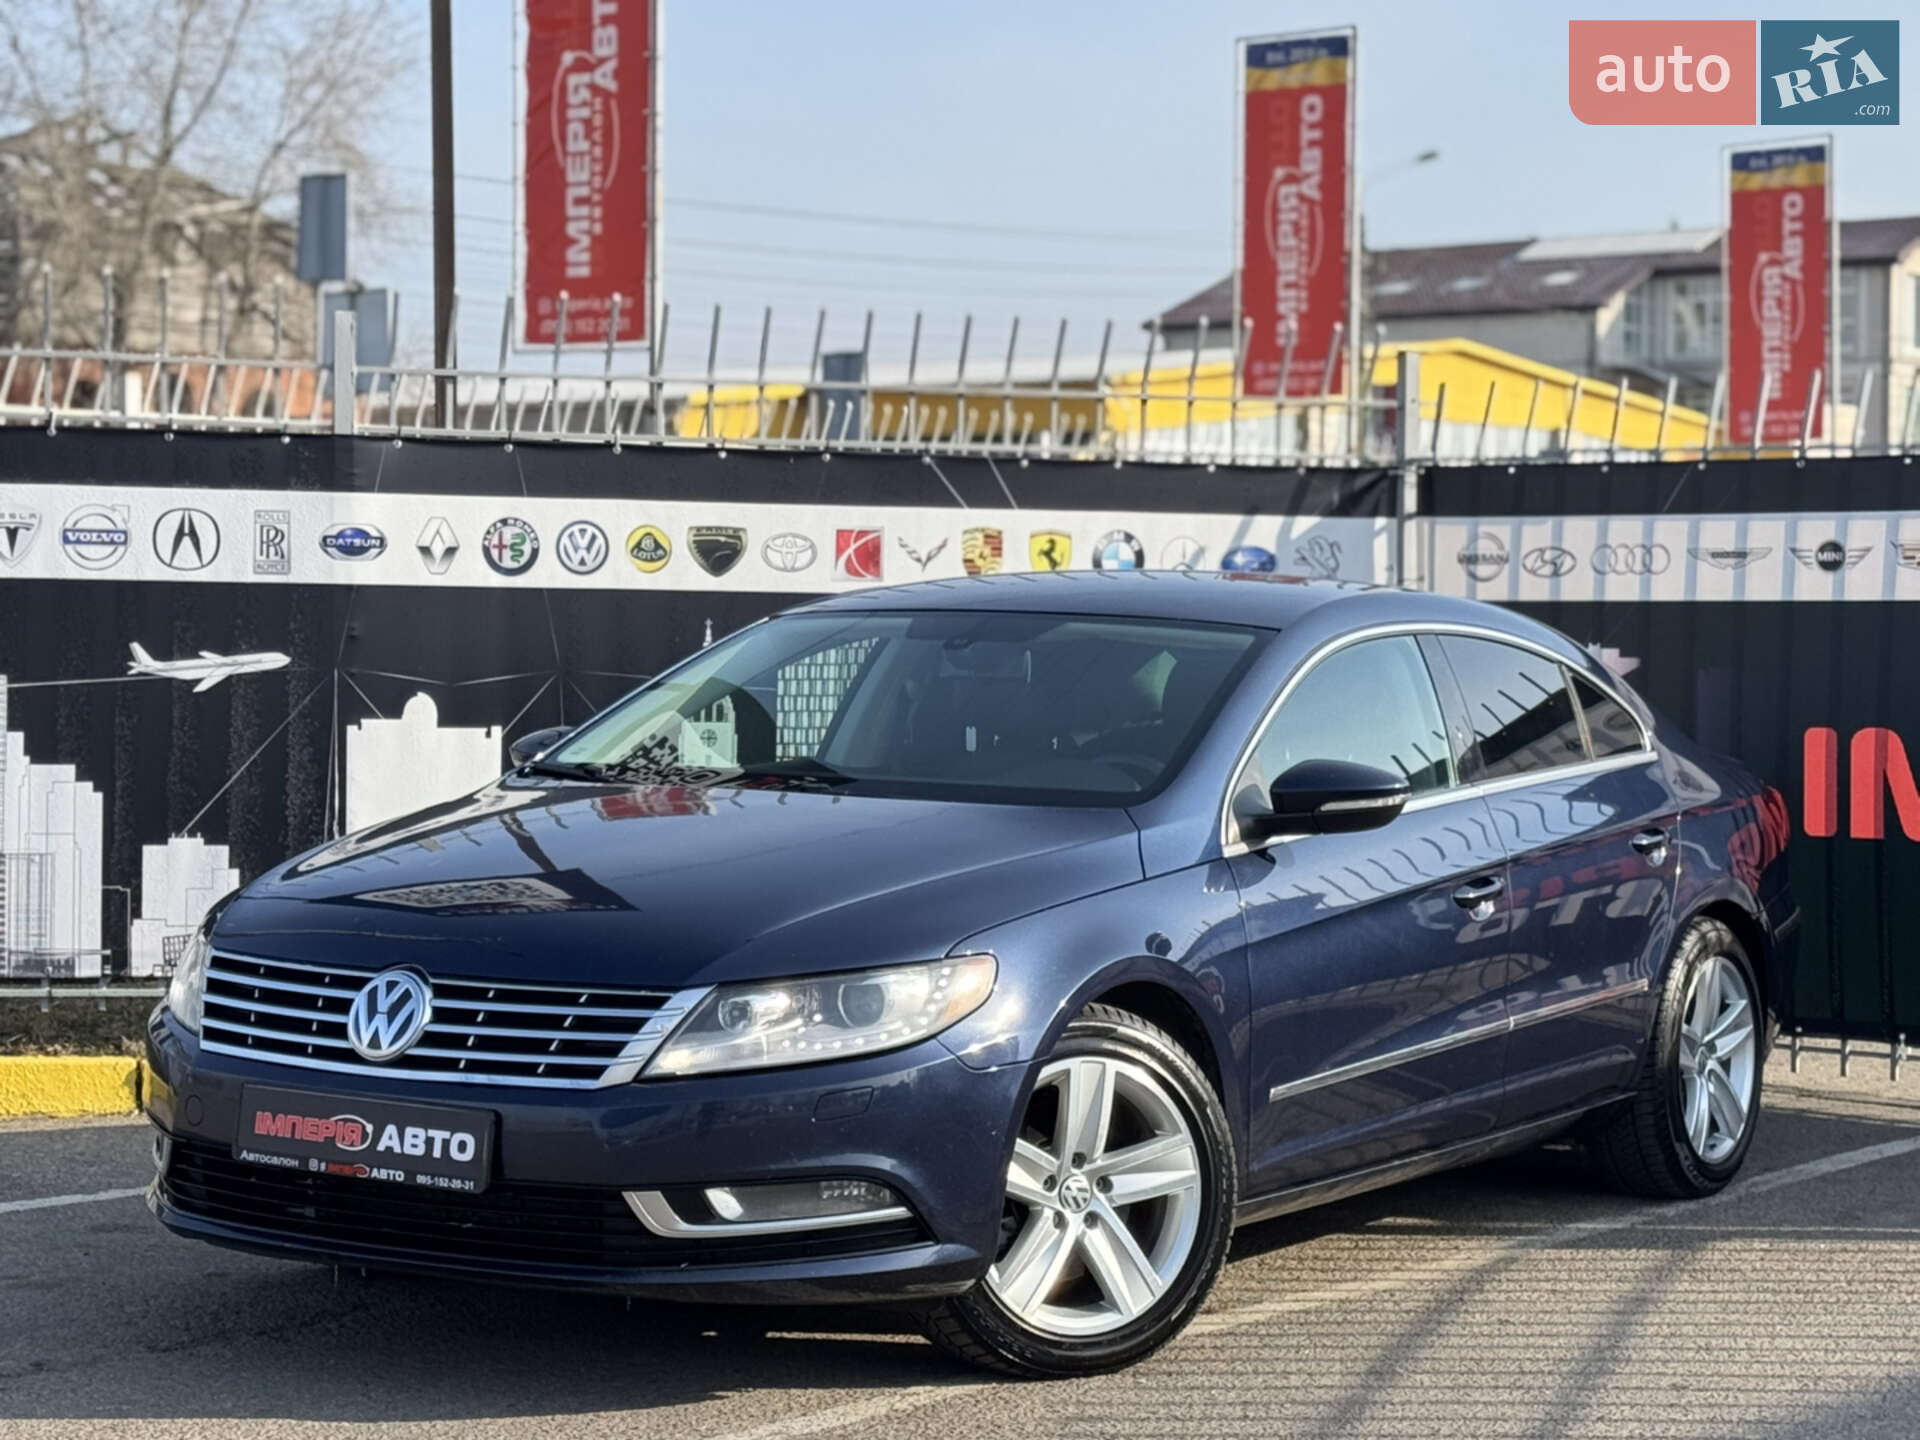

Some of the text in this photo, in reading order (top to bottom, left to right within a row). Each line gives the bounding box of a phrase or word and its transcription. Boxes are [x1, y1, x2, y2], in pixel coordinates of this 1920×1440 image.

[592, 0, 618, 93] АВТ
[1300, 94, 1323, 200] АВТО
[1783, 193, 1804, 280] АВТО
[65, 531, 125, 543] VOLVO
[326, 537, 380, 547] DATSUN
[1818, 551, 1843, 562] MINI
[254, 1111, 476, 1162] ІМПЕРІЯ АВТО
[371, 1167, 405, 1182] АВТО
